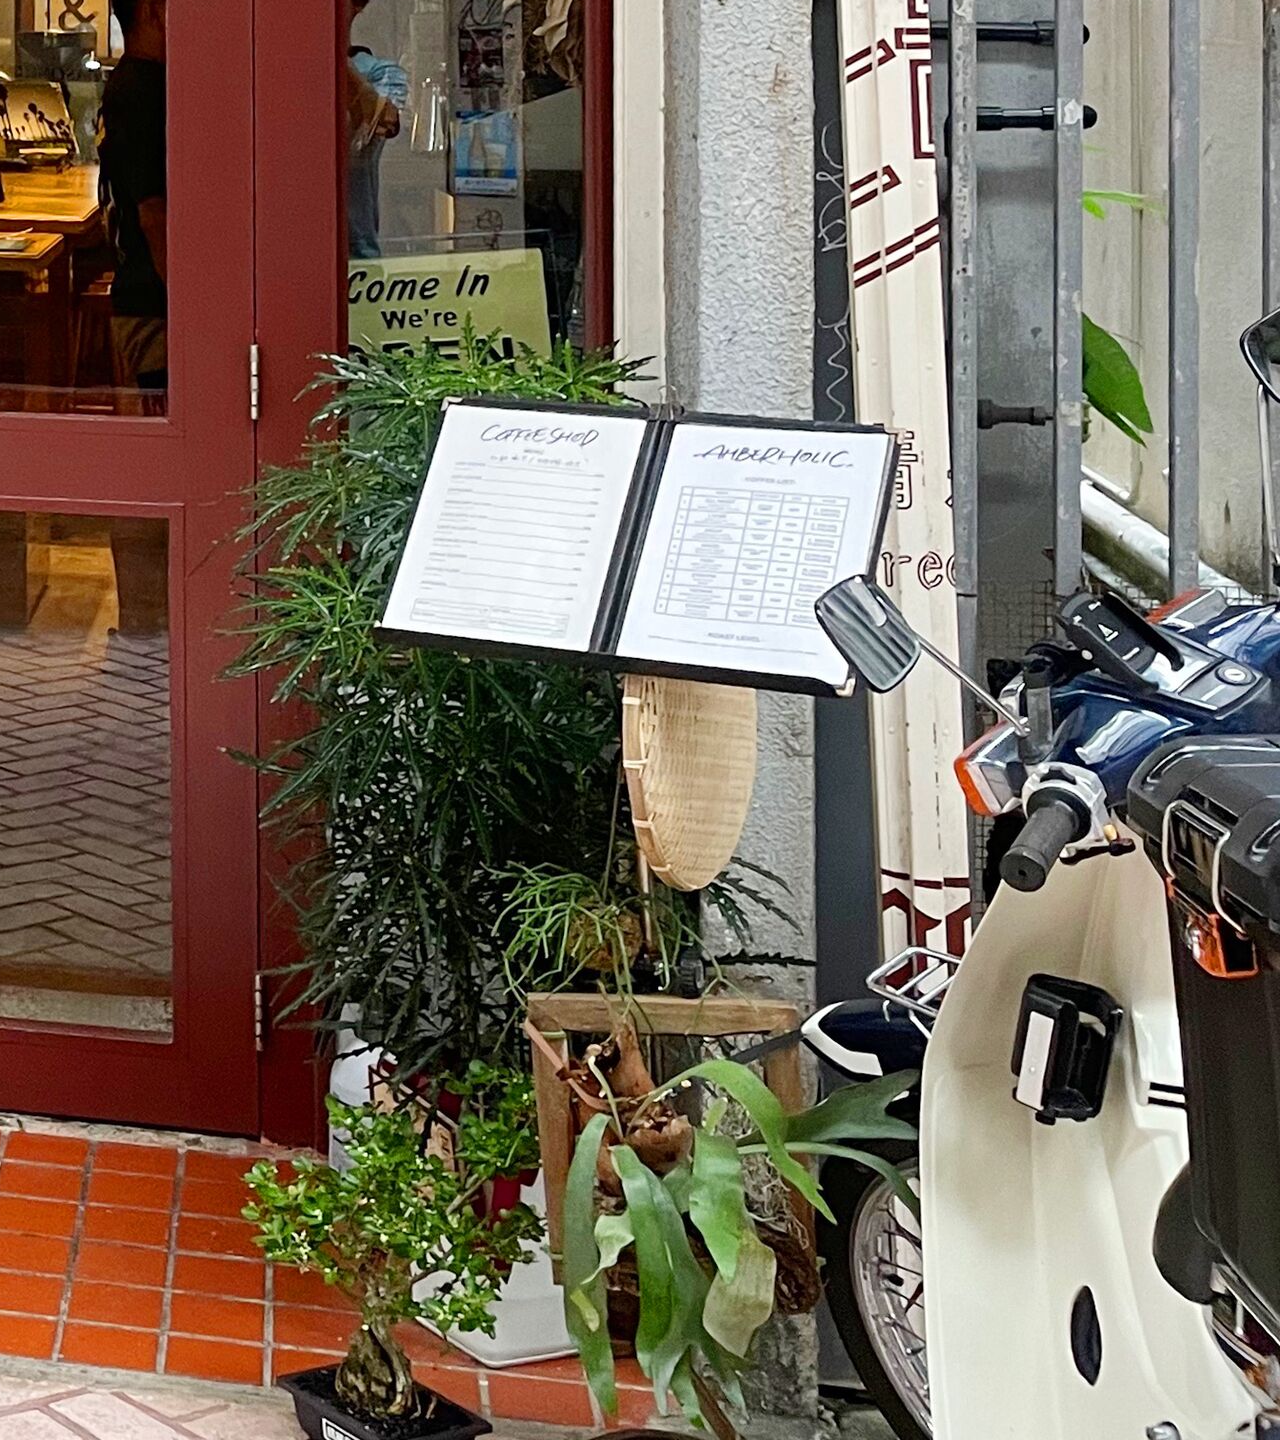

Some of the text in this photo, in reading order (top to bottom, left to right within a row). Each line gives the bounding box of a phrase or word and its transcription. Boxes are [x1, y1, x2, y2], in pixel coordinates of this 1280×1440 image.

[348, 264, 490, 305] Come In
[380, 308, 458, 330] We're
